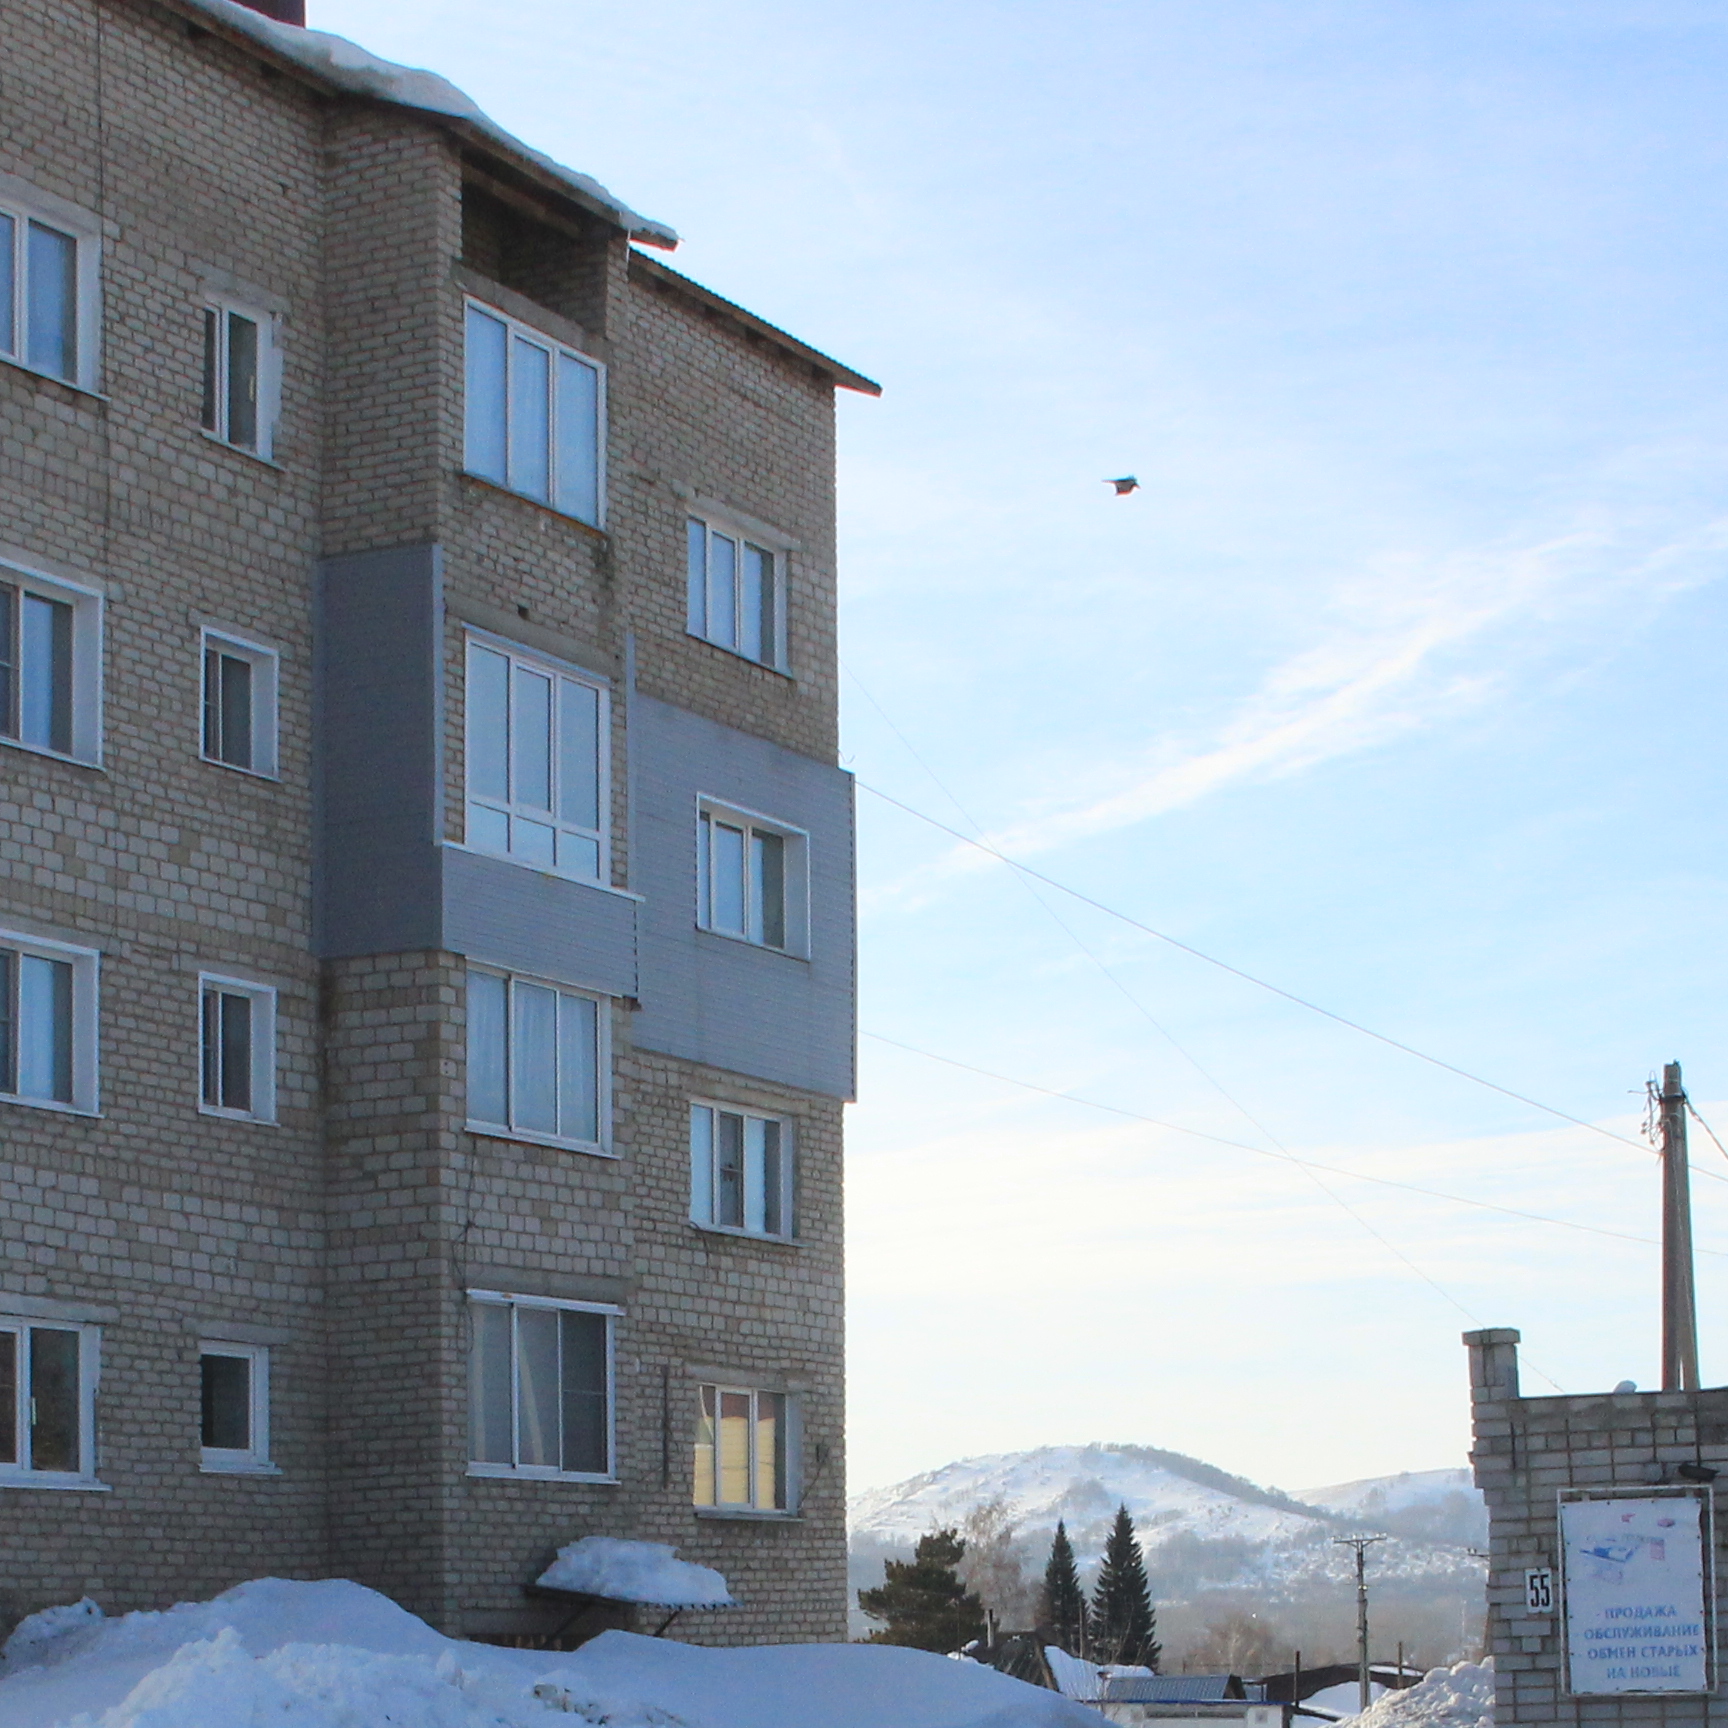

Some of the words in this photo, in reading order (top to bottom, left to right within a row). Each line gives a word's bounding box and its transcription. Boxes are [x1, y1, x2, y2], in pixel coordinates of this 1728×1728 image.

[1529, 1574, 1551, 1608] 55
[1605, 1605, 1678, 1620] ПРОДАЖА
[1584, 1624, 1700, 1640] ОБСЛУЖИВАНИЕ
[1587, 1646, 1636, 1660] ОБМЕН
[1641, 1644, 1698, 1659] СТАРЫХ
[1607, 1666, 1626, 1679] НА
[1630, 1665, 1681, 1678] НОВЫЕ
